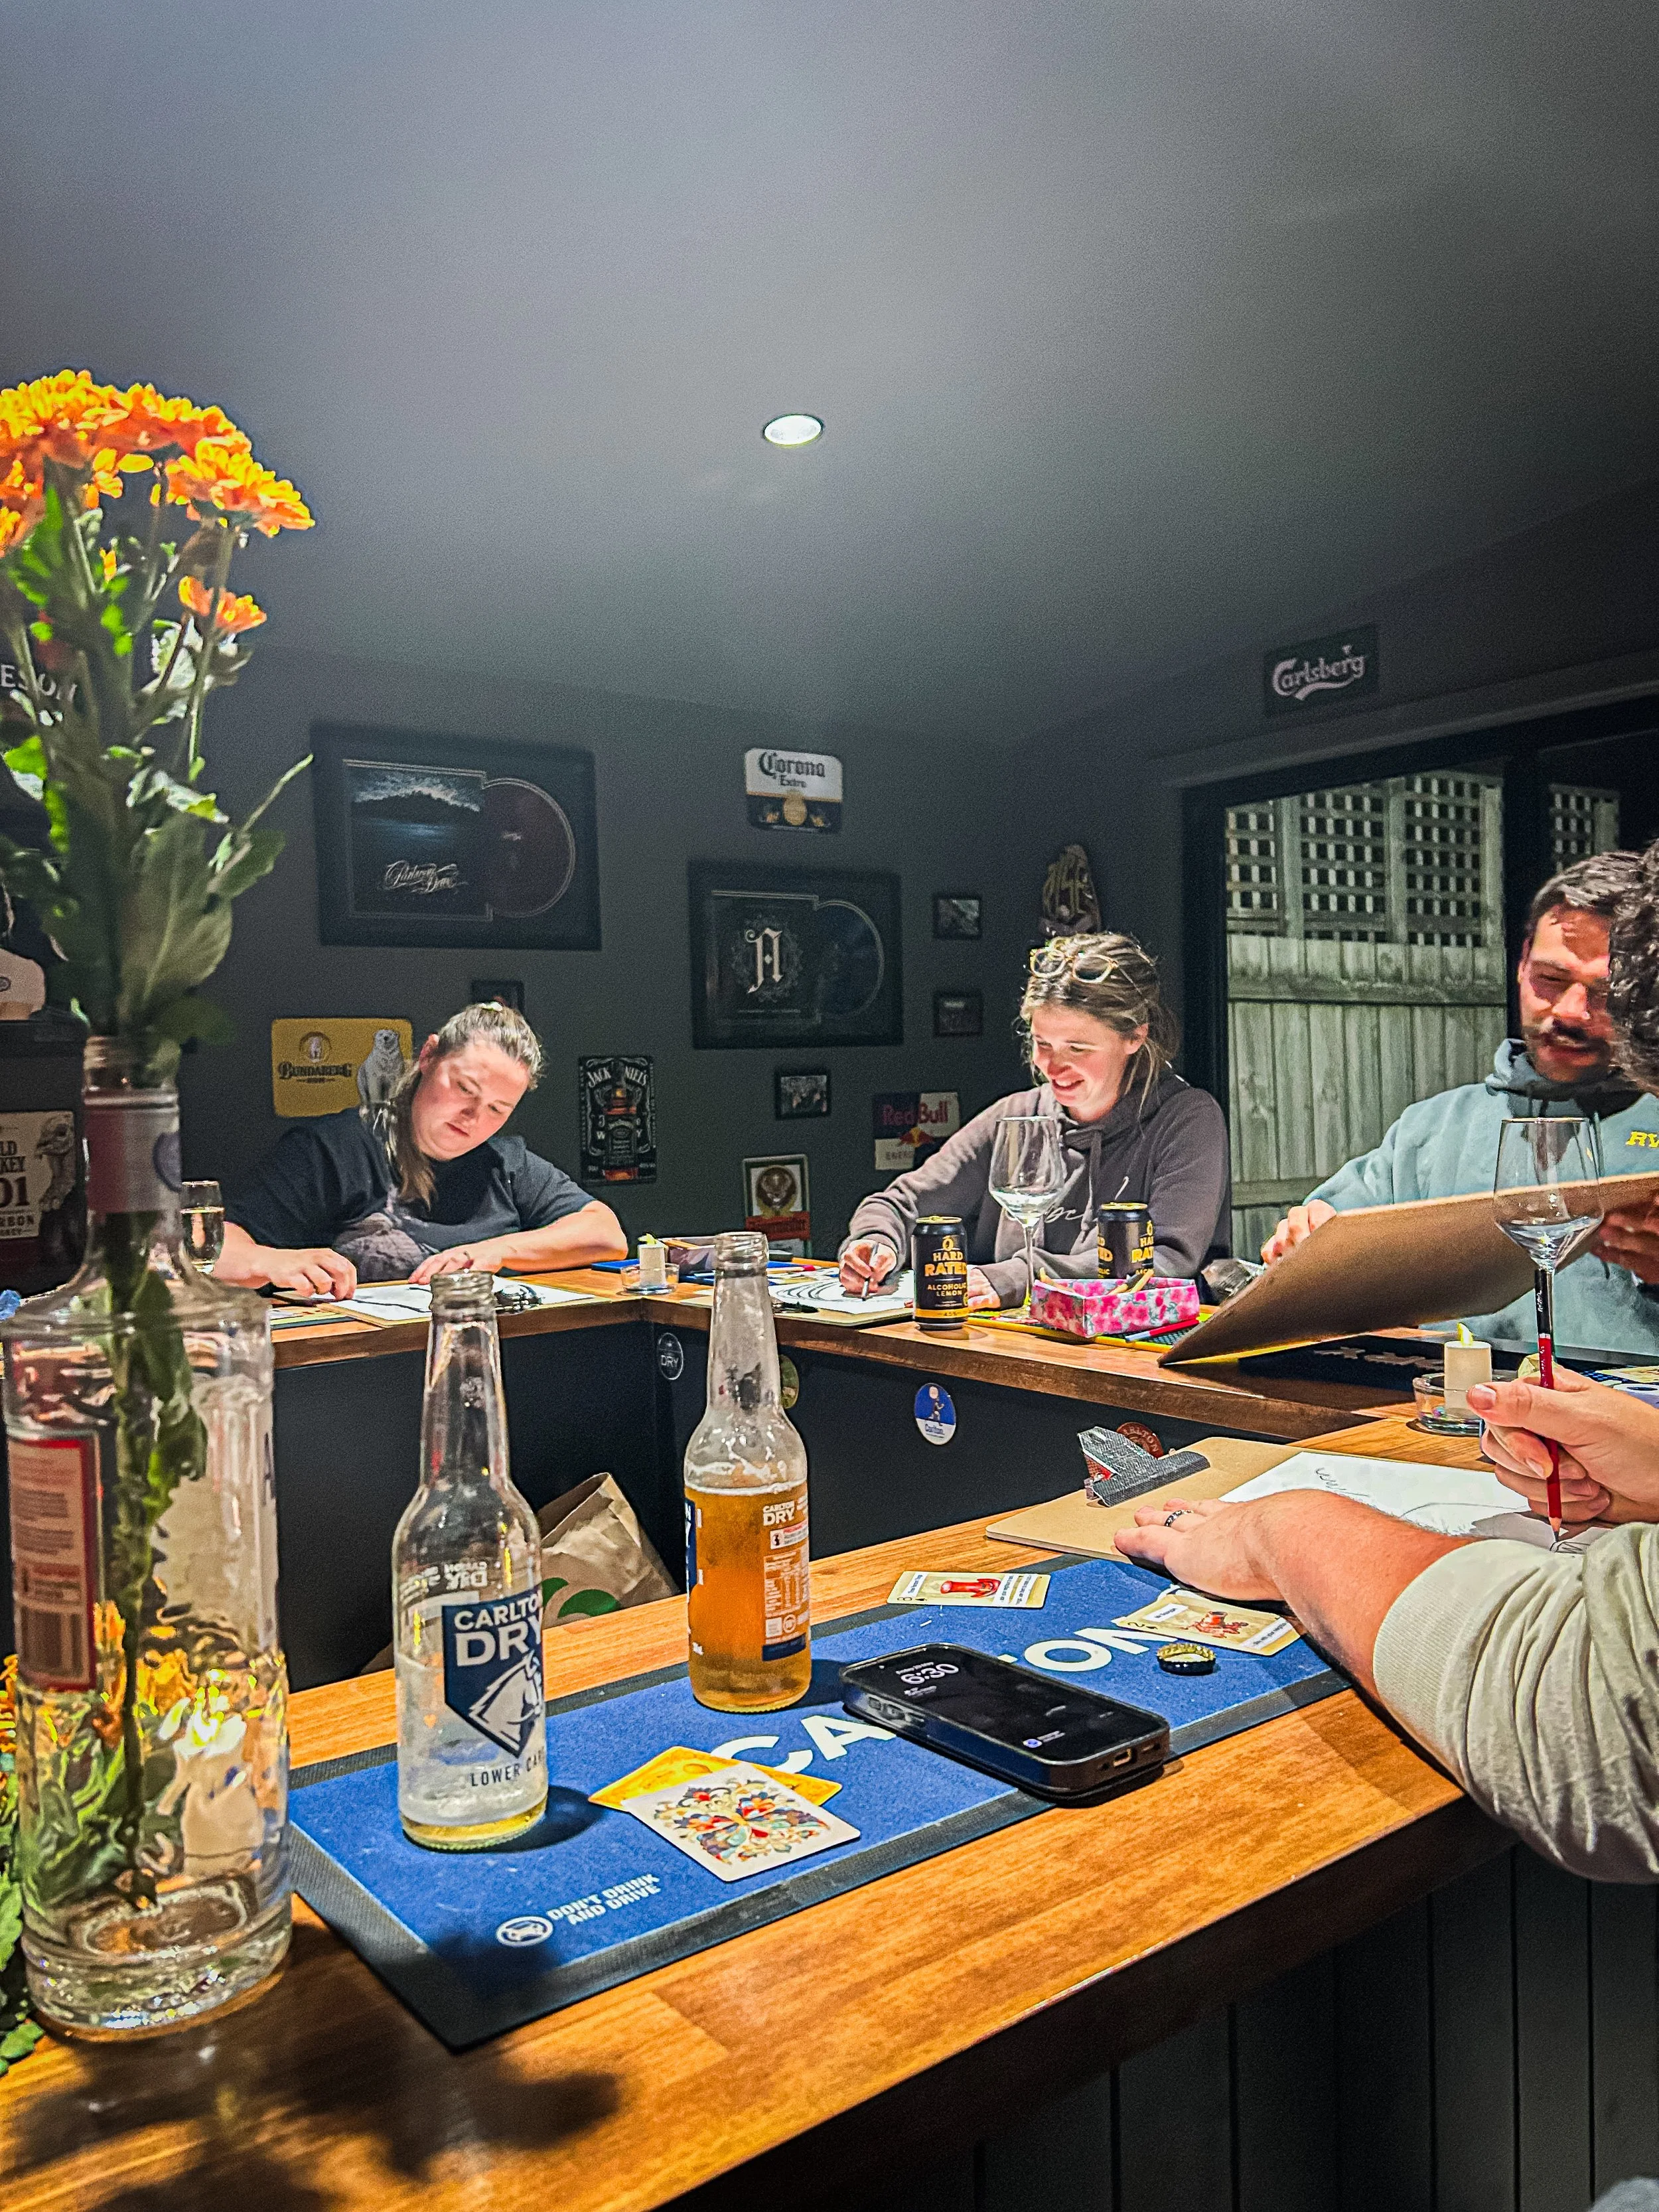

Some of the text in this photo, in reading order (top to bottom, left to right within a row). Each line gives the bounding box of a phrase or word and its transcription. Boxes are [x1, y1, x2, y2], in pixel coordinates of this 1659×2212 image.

[1273, 654, 1366, 701] Carlsberg
[758, 751, 826, 780] Corona
[587, 1066, 612, 1088] JACK
[883, 1100, 949, 1126] Red Bull
[932, 1251, 964, 1262] HARD
[661, 1355, 679, 1368] DRY
[762, 1507, 795, 1526] DRY
[455, 1607, 543, 1666] DRY
[900, 1663, 960, 1686] 6:30
[470, 1763, 520, 1787] LOWER
[546, 1873, 660, 1921] DON'T DRINK
[567, 1884, 662, 1925] AND DRIVE
